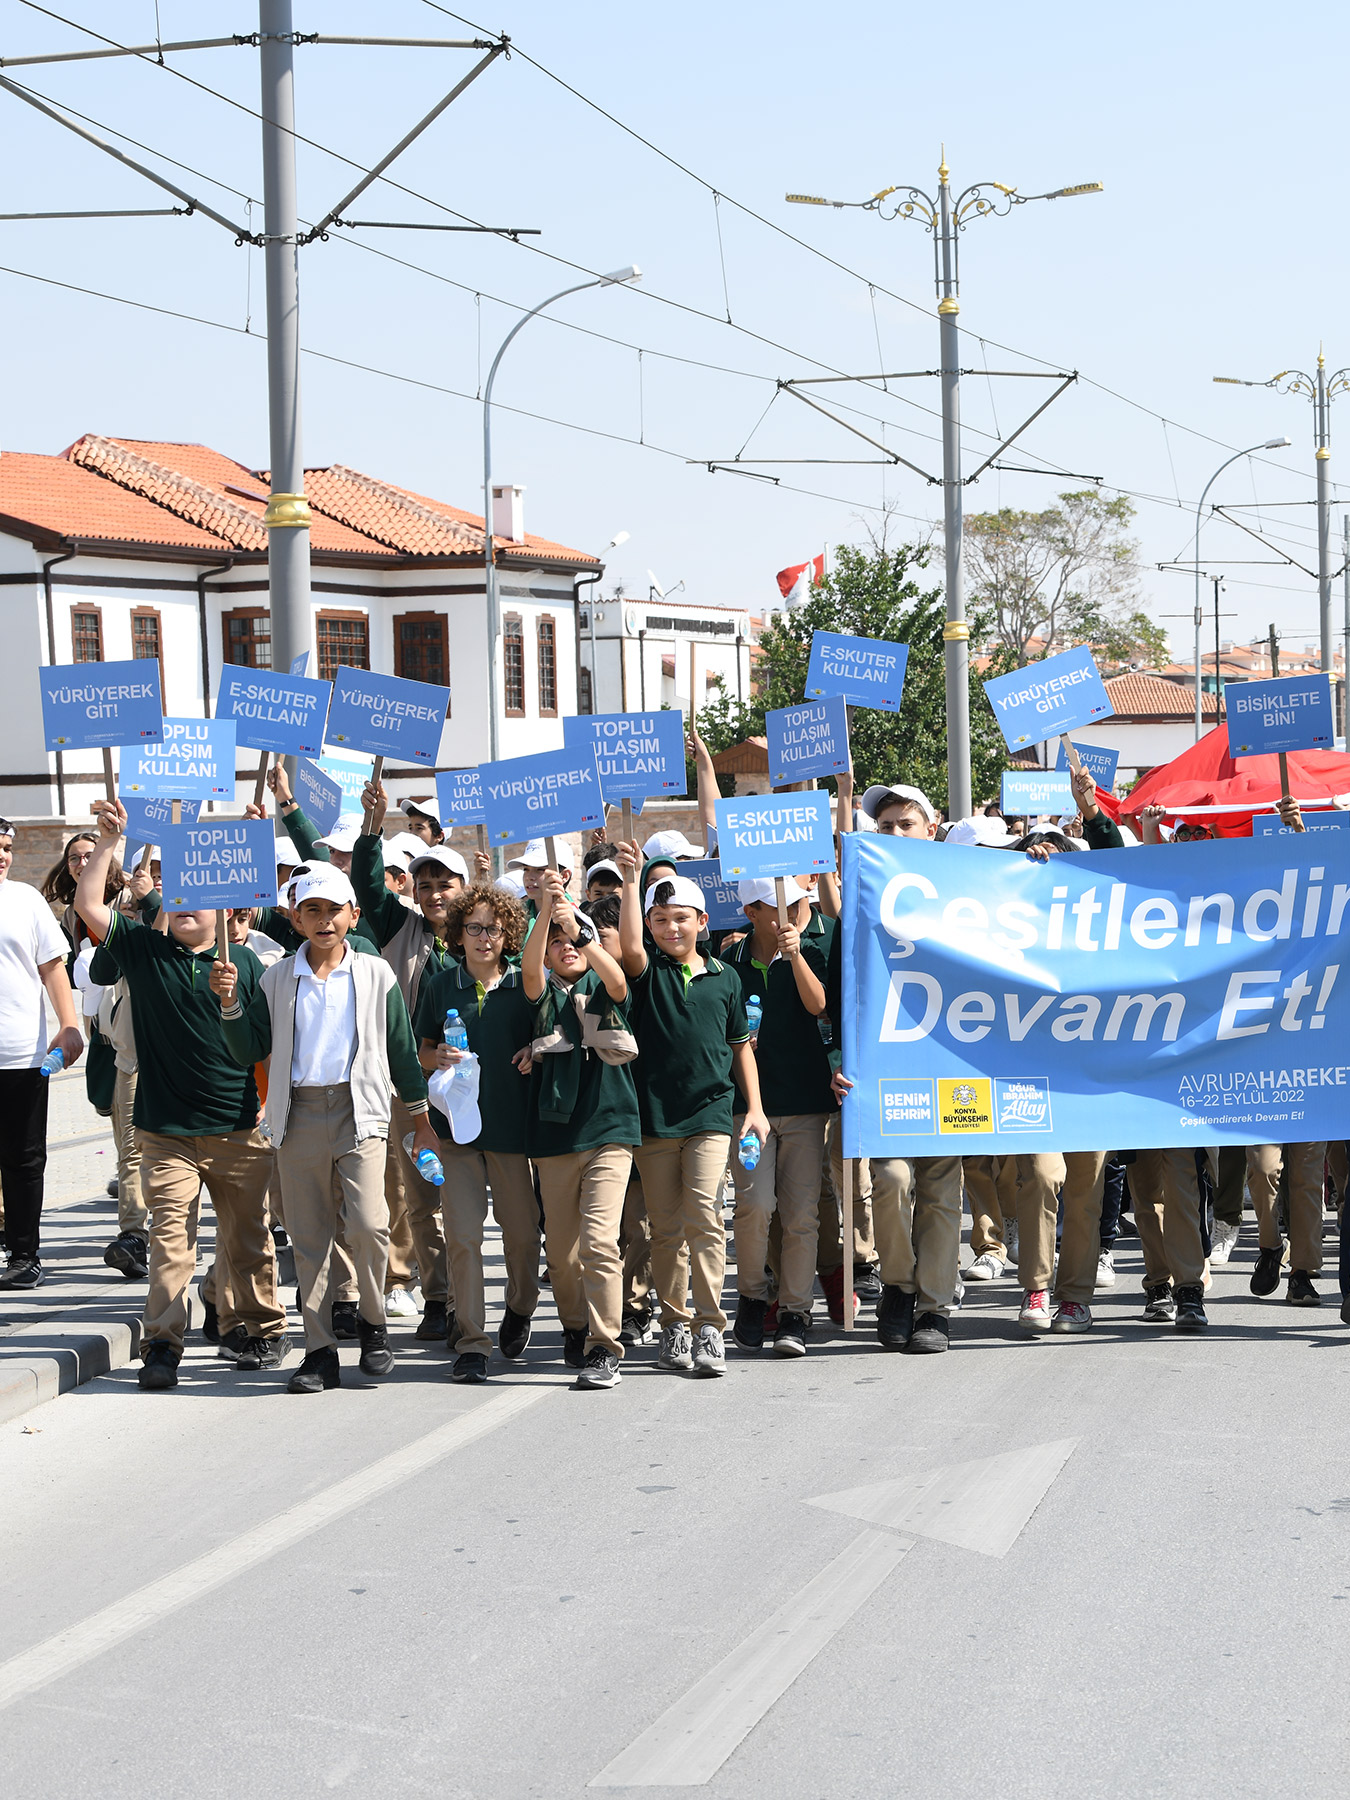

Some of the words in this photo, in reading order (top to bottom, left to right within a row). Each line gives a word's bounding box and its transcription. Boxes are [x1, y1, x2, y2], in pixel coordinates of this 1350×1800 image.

[820, 645, 897, 670] E-SKUTER
[822, 661, 889, 685] KULLAN!
[48, 683, 154, 704] YÜRÜYEREK
[229, 681, 317, 710] E-SKUTER
[996, 666, 1094, 711] YÜRÜYEREK
[86, 704, 119, 720] GİT!
[340, 689, 440, 723] YÜRÜYEREK
[1035, 692, 1067, 714] GİT!
[1236, 691, 1321, 714] BİSİKLETE
[232, 701, 308, 727] KULLAN!
[370, 712, 402, 732] GİT!
[784, 706, 826, 728] TOPLU
[1263, 709, 1296, 727] BİN!
[163, 724, 209, 740] OPLU
[592, 719, 654, 737] TOPLU
[783, 724, 830, 746] ULAŞIM
[144, 743, 213, 762] ULAŞIM
[780, 740, 835, 764] KULLAN!
[138, 760, 217, 778] KULLAN!
[599, 757, 666, 776] ULLAN!
[299, 769, 337, 807] BİSİKLETE
[454, 773, 480, 786] TOP
[488, 768, 592, 801] YÜRÜYEREK
[1007, 782, 1072, 792] YÜRÜYEREK
[309, 791, 325, 812] BİN!
[451, 799, 484, 811] KULL
[526, 792, 559, 811] GİT!
[144, 803, 168, 822] GİT!
[726, 806, 819, 829] E-SKUTER
[187, 828, 247, 847] TOPLU
[734, 826, 814, 848] KULLAN!
[184, 848, 252, 869] ULAŞIM
[180, 868, 258, 887] KULLAN!
[715, 888, 740, 904] BİN
[878, 969, 1187, 1044] Devam
[1215, 964, 1339, 1042] Et!
[1009, 1082, 1036, 1093] UĞUR
[1223, 1090, 1269, 1106] EYLÜL
[1272, 1089, 1304, 1103] 2022
[943, 1114, 989, 1124] BÜYÜKŞEHİR
[1001, 1100, 1047, 1124] Altay
[1180, 1114, 1253, 1128] Çeşitlendirerek
[1255, 1112, 1288, 1123] Devam
[1290, 1111, 1304, 1121] Et!
